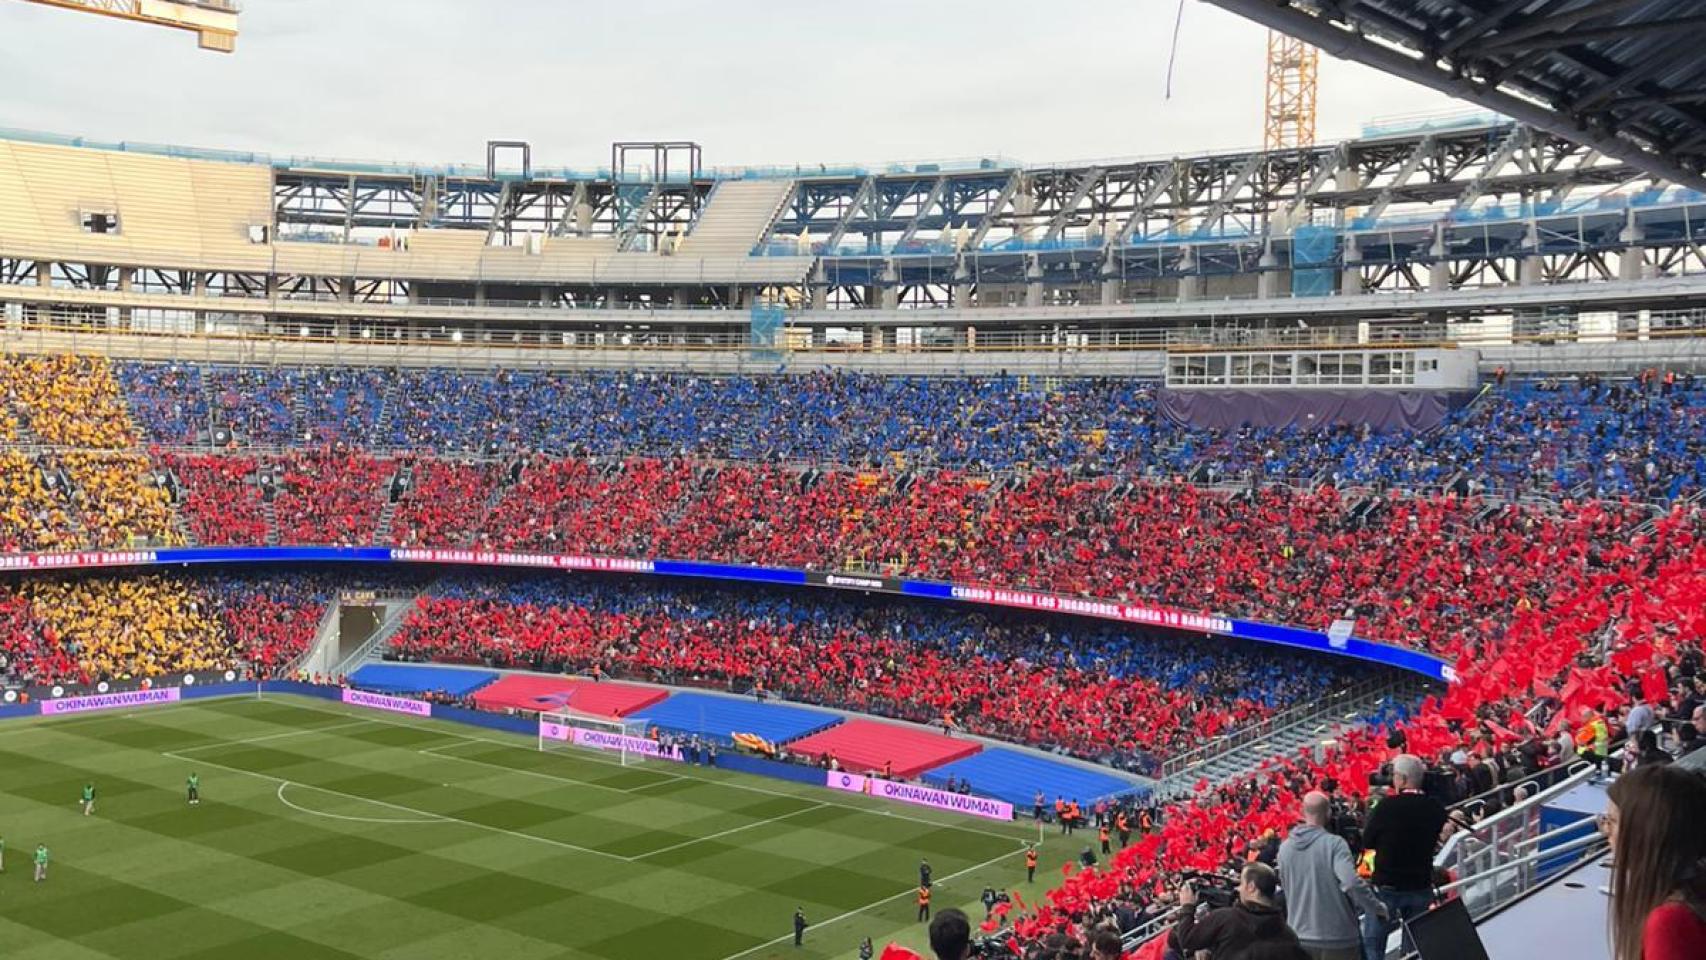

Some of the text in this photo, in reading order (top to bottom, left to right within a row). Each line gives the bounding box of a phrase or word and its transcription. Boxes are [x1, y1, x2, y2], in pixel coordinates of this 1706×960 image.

[82, 553, 98, 564] TU
[103, 552, 157, 563] BANDERA
[391, 549, 432, 559] CUANDO
[477, 552, 495, 562] LOS
[595, 558, 608, 569] TU
[611, 558, 654, 570] BANDERA
[951, 587, 992, 599] CUANDO
[1037, 595, 1056, 607] LOS
[1181, 613, 1233, 631] BANDERA
[885, 783, 1000, 816] OKINAWAN WUMAN
